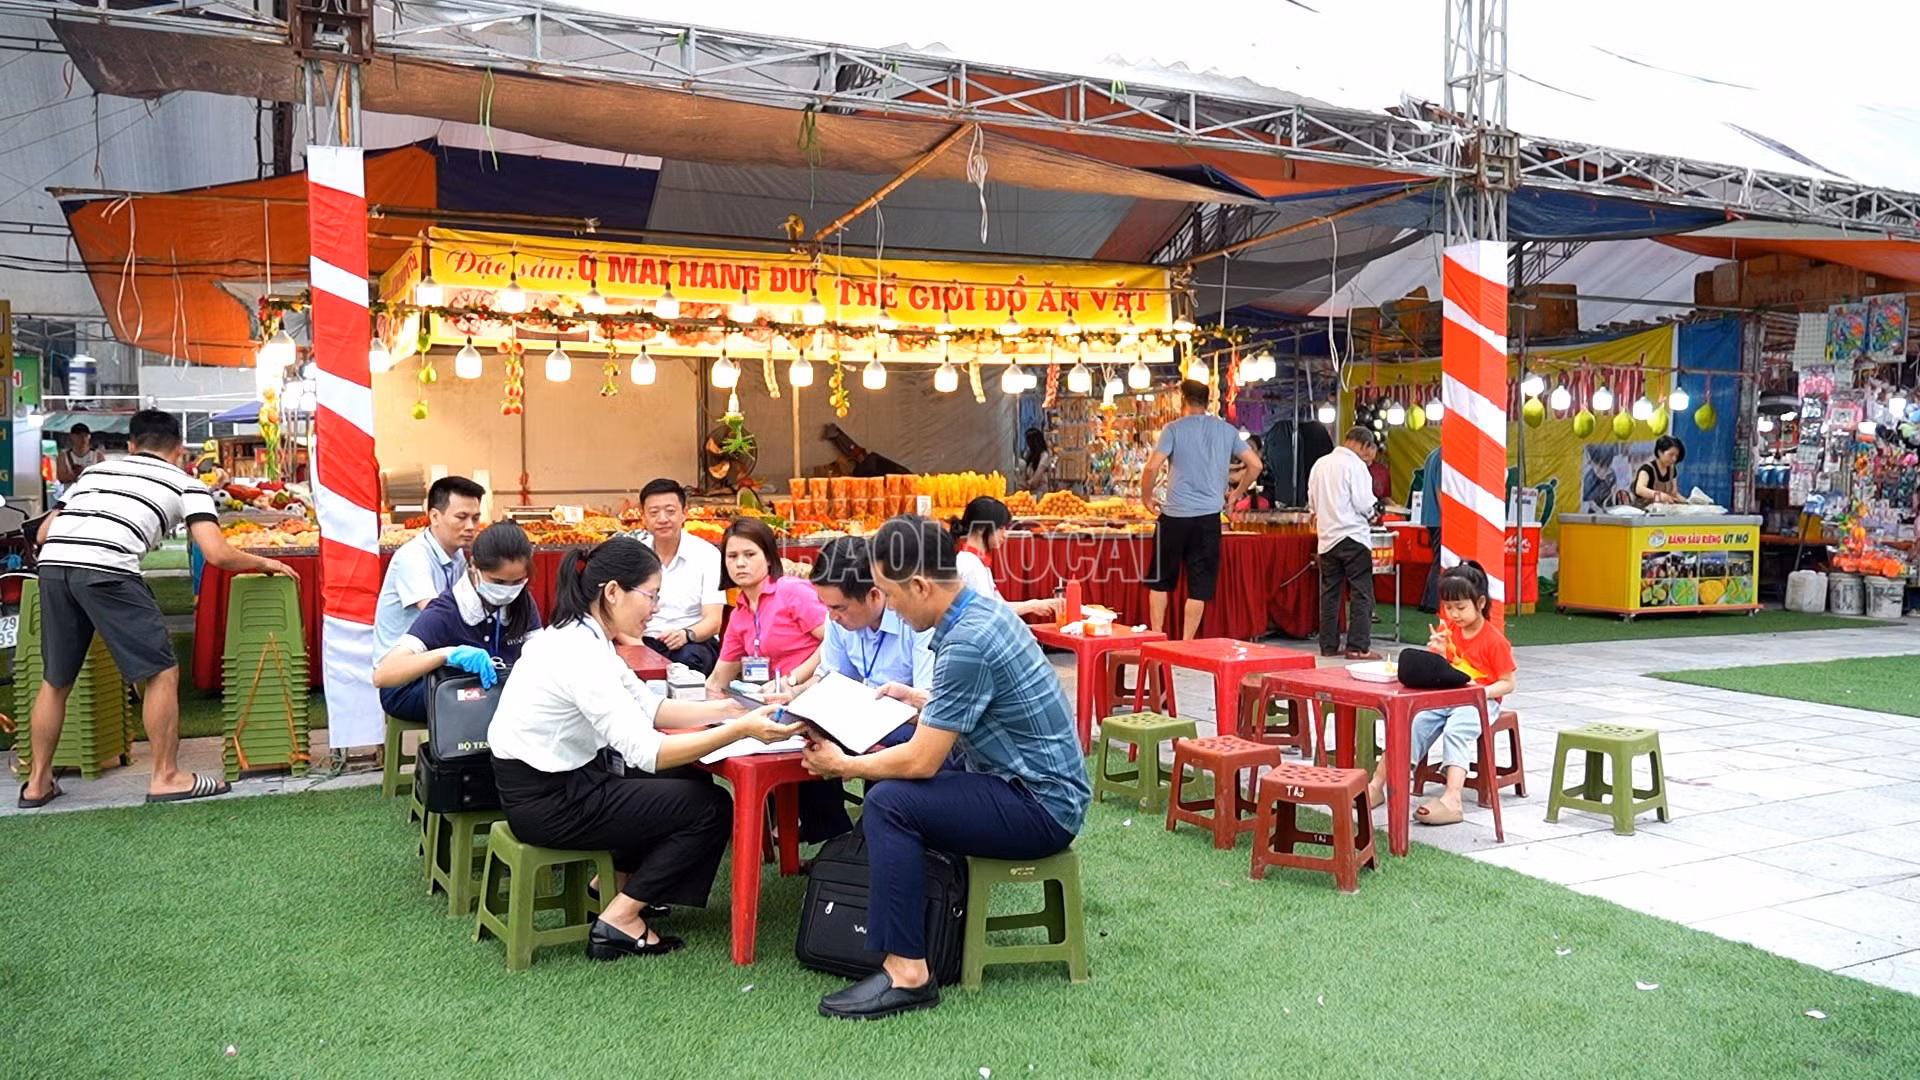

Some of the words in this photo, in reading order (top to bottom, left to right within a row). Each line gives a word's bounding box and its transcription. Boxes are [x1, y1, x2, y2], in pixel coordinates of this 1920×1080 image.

[446, 249, 506, 280] Đặc
[608, 256, 669, 286] MAI
[985, 274, 1027, 312] ĐỒ
[1037, 280, 1080, 312] ĂN
[1089, 281, 1152, 319] VẶT
